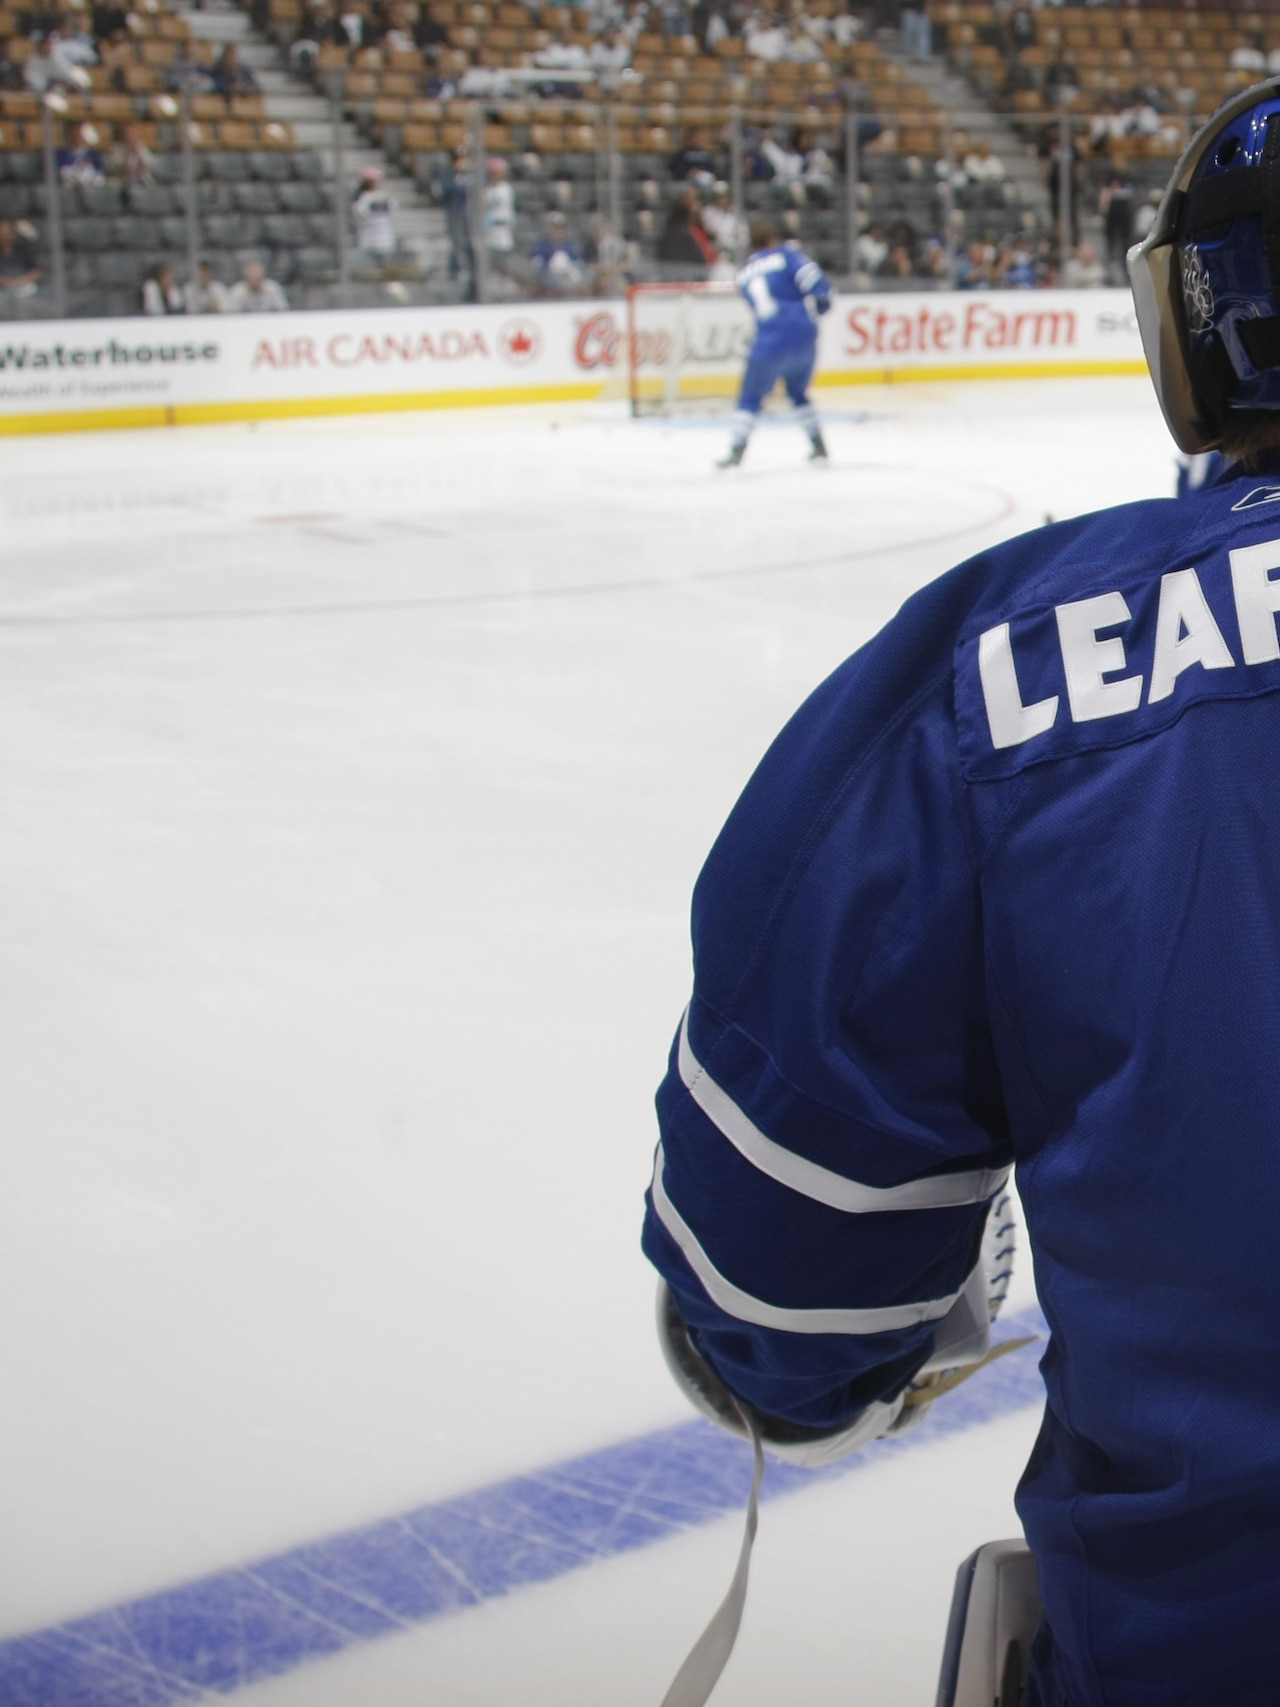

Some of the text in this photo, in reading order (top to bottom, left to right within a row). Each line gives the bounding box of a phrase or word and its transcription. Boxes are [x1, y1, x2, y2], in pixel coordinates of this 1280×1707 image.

[0, 336, 219, 369] Waterhouse
[252, 329, 492, 370] AIR CANADA
